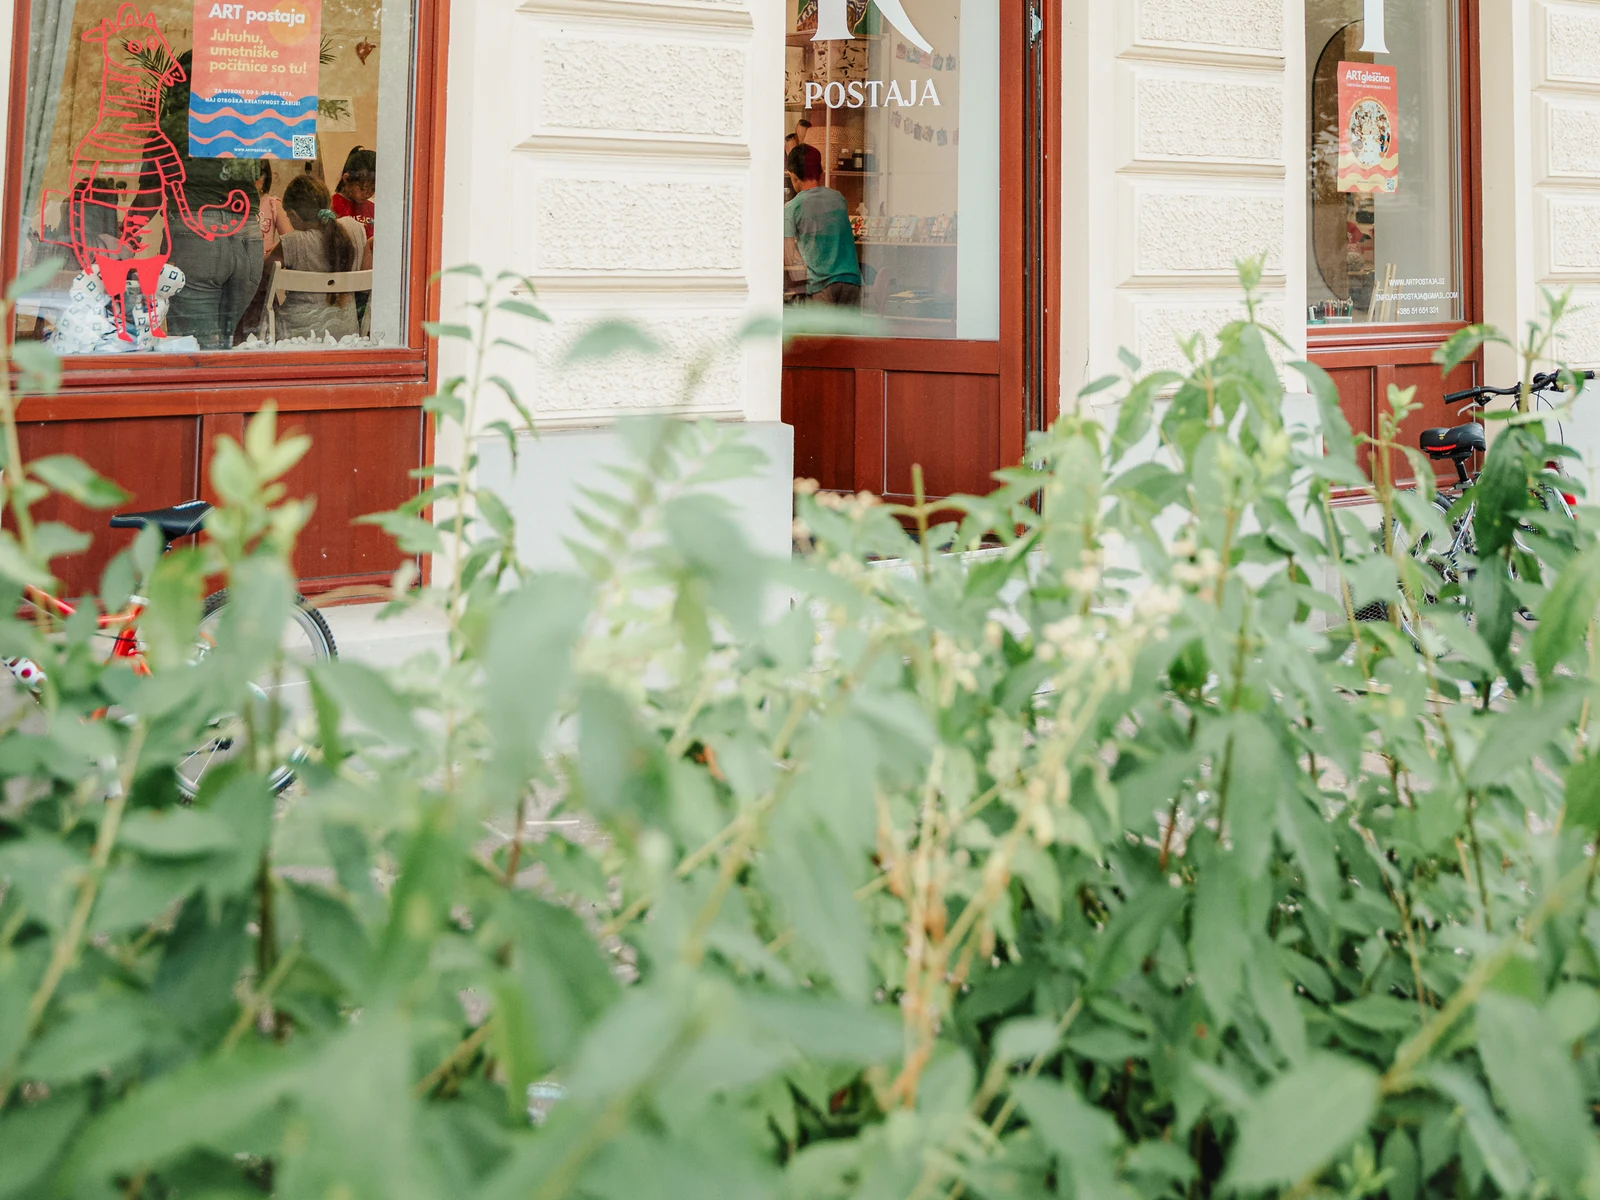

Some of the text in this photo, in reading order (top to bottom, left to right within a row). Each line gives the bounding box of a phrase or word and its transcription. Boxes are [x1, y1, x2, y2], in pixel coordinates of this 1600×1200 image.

[208, 3, 305, 28] ART postaja
[210, 28, 263, 45] Juhuhu,
[210, 45, 279, 59] umetniške
[209, 58, 307, 74] počitnice so tu!
[804, 78, 941, 109] POSTAJA
[1388, 277, 1446, 286] WWW.ARTPOSTAJA.SI
